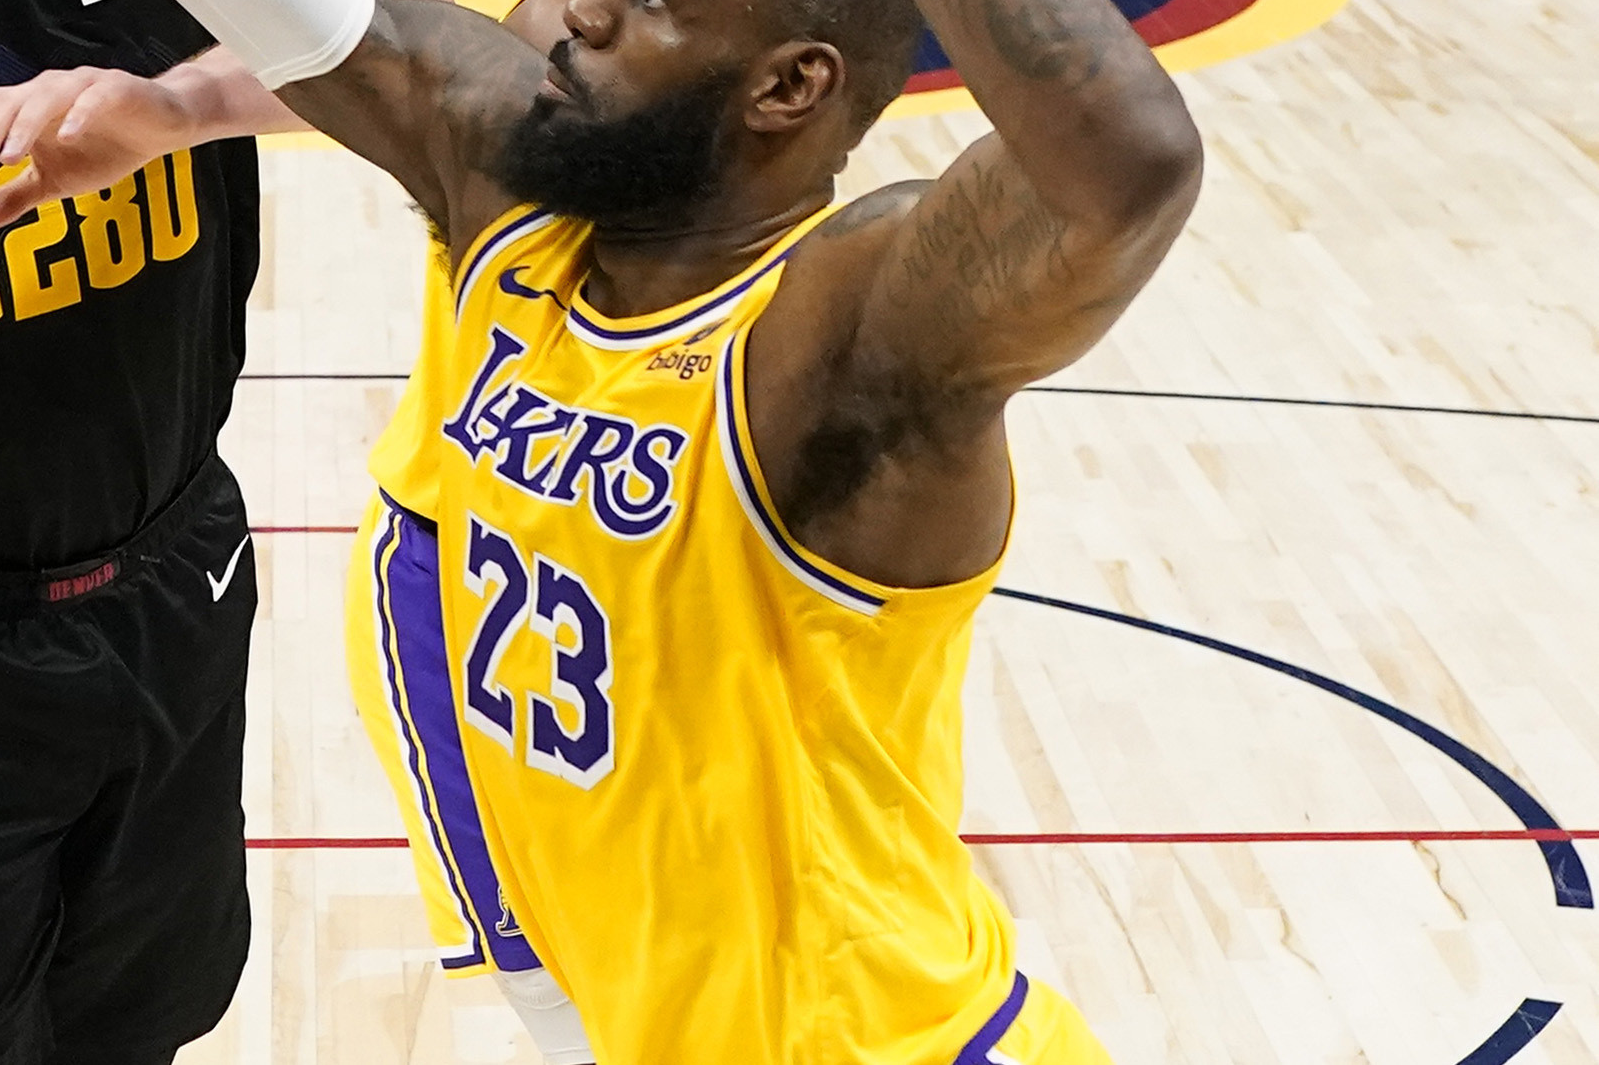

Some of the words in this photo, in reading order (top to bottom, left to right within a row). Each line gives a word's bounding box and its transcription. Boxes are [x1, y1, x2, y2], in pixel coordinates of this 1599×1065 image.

[442, 322, 688, 539] LAKRS
[646, 349, 712, 380] bbigo
[464, 510, 614, 790] 23
